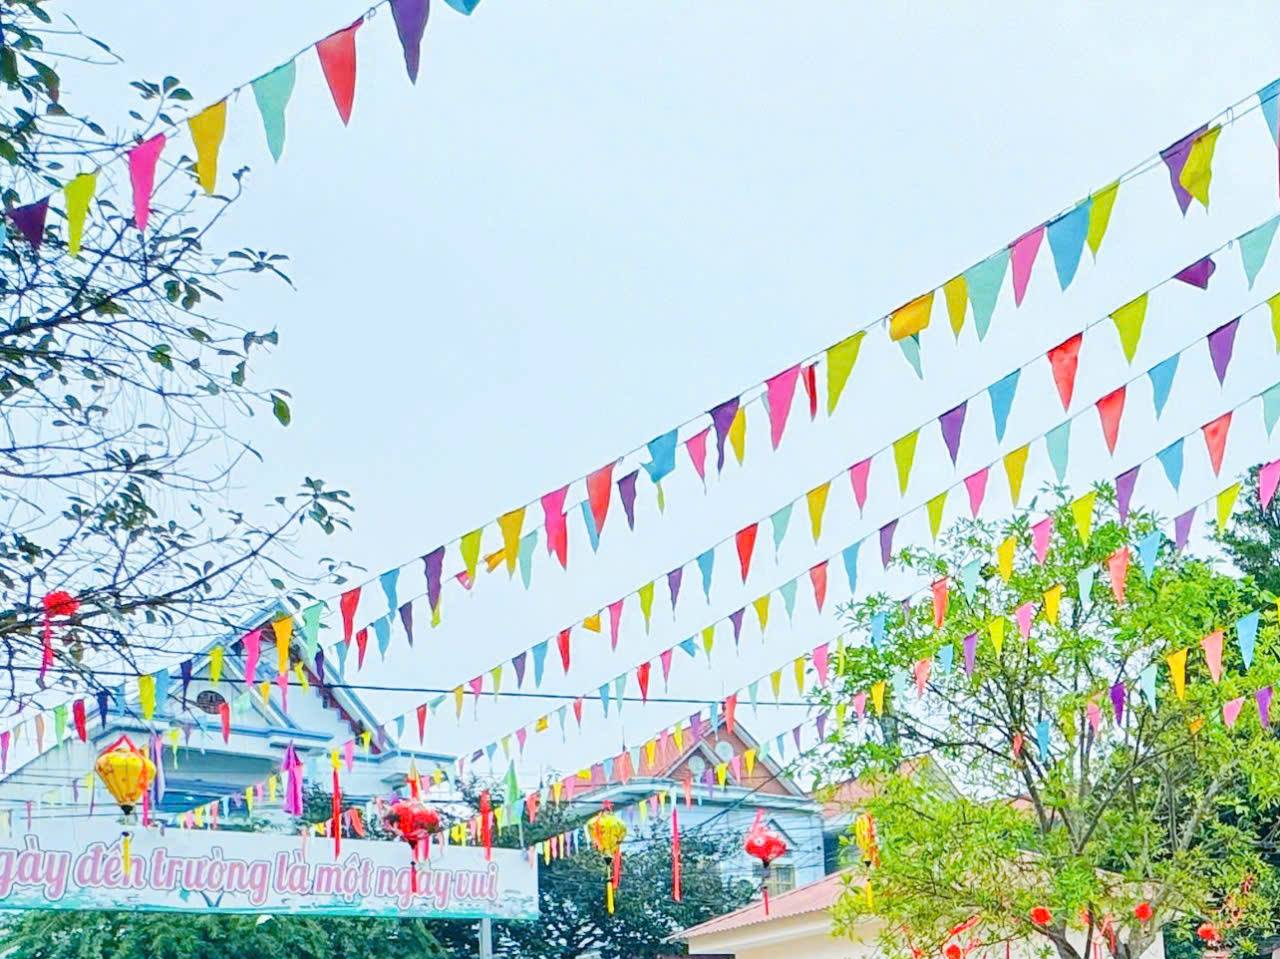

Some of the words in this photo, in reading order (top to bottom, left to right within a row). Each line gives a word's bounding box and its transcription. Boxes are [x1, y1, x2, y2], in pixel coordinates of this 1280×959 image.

[150, 847, 271, 905] trường
[274, 850, 310, 893] là
[313, 852, 373, 902] một
[455, 862, 498, 900] vui
